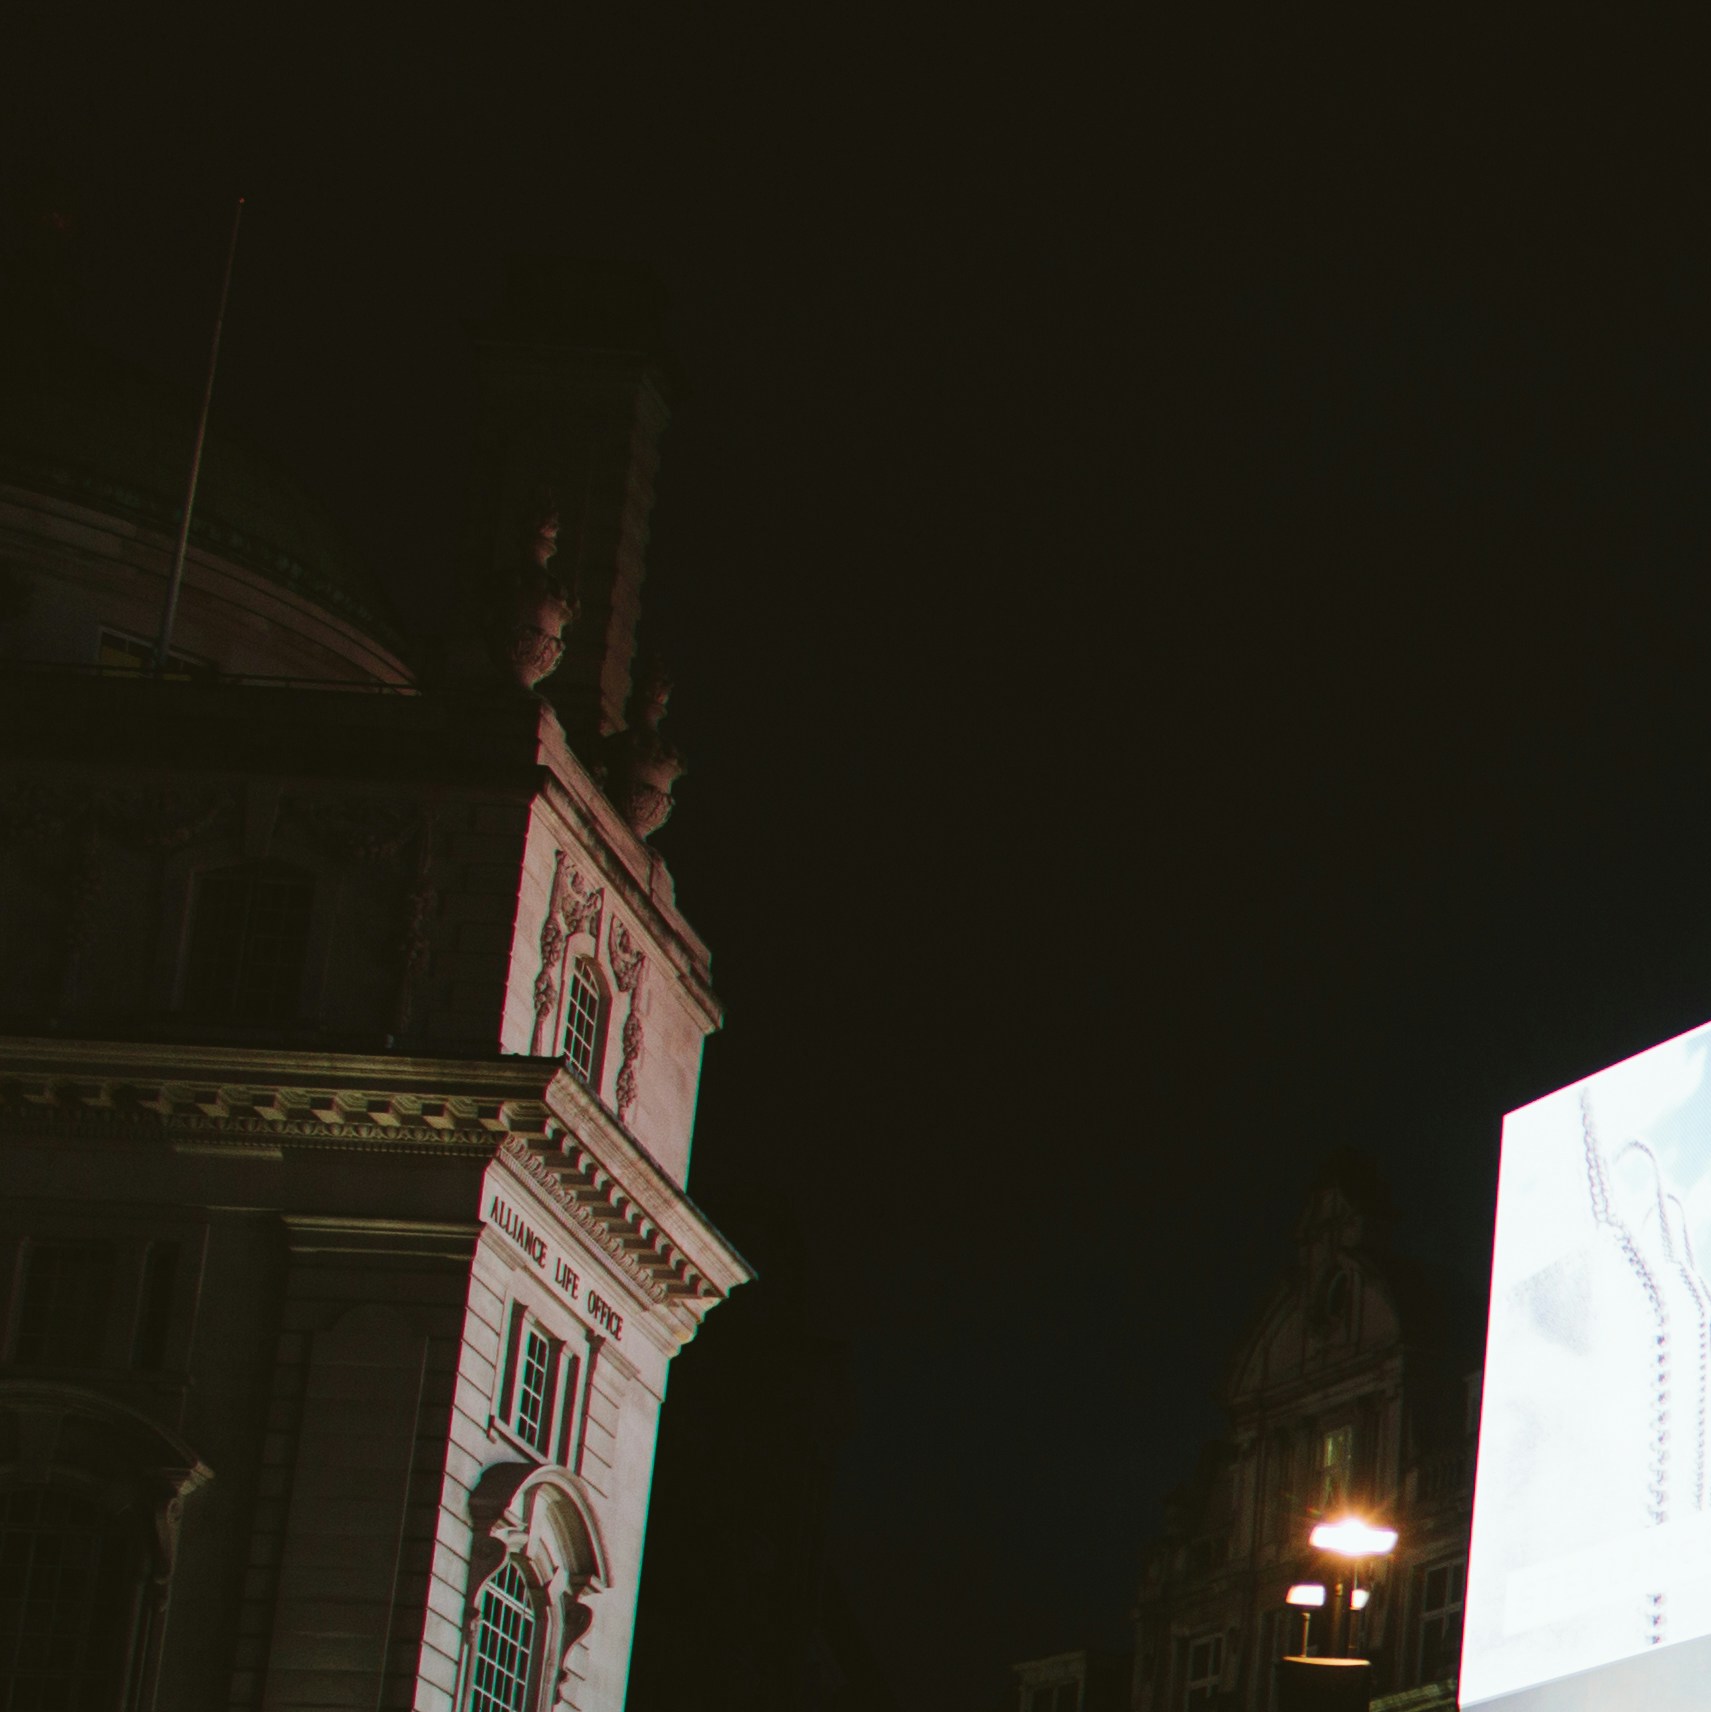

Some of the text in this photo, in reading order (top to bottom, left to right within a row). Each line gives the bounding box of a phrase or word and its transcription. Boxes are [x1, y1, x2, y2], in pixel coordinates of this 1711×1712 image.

[490, 1195, 623, 1341] ALLIANCE LIFE OFFICE
